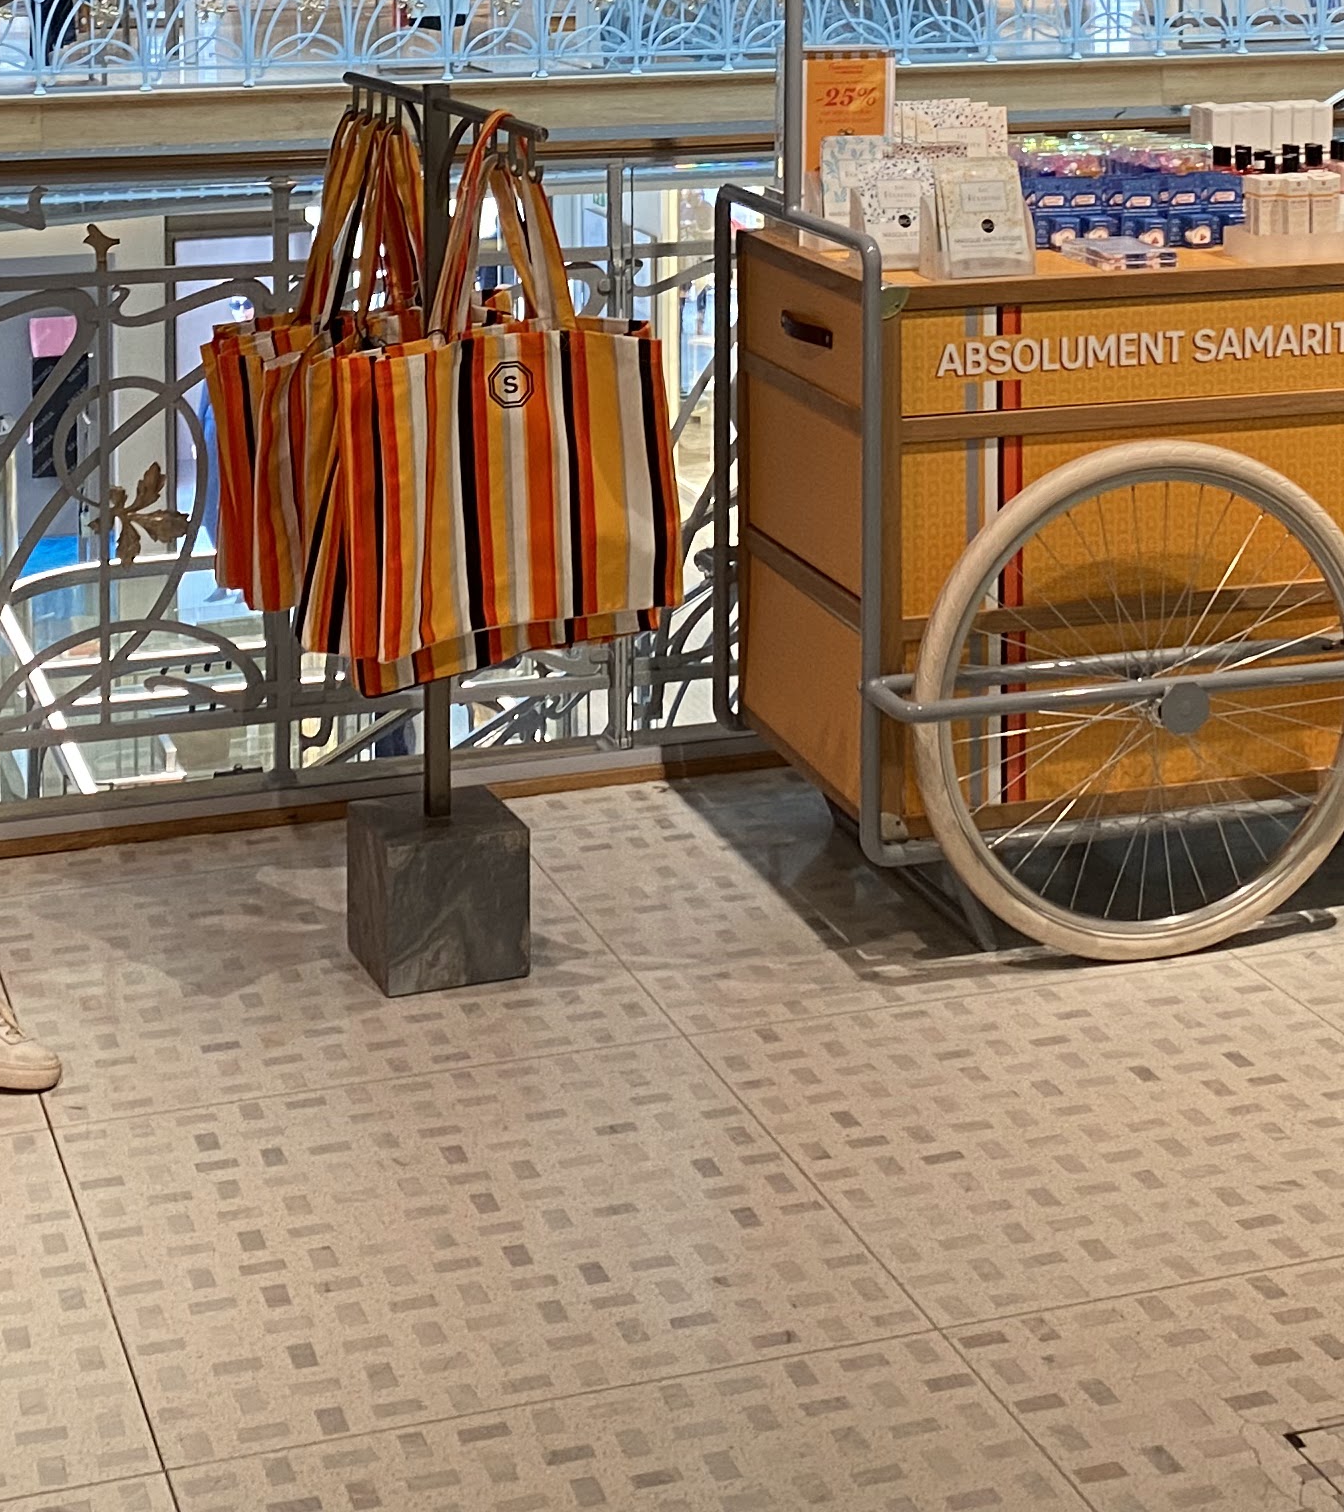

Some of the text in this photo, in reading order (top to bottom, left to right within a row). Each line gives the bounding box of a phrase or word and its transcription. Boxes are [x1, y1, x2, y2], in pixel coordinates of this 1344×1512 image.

[815, 87, 877, 107] -25%
[936, 330, 1186, 377] ABSOLUMENT
[503, 375, 519, 393] S
